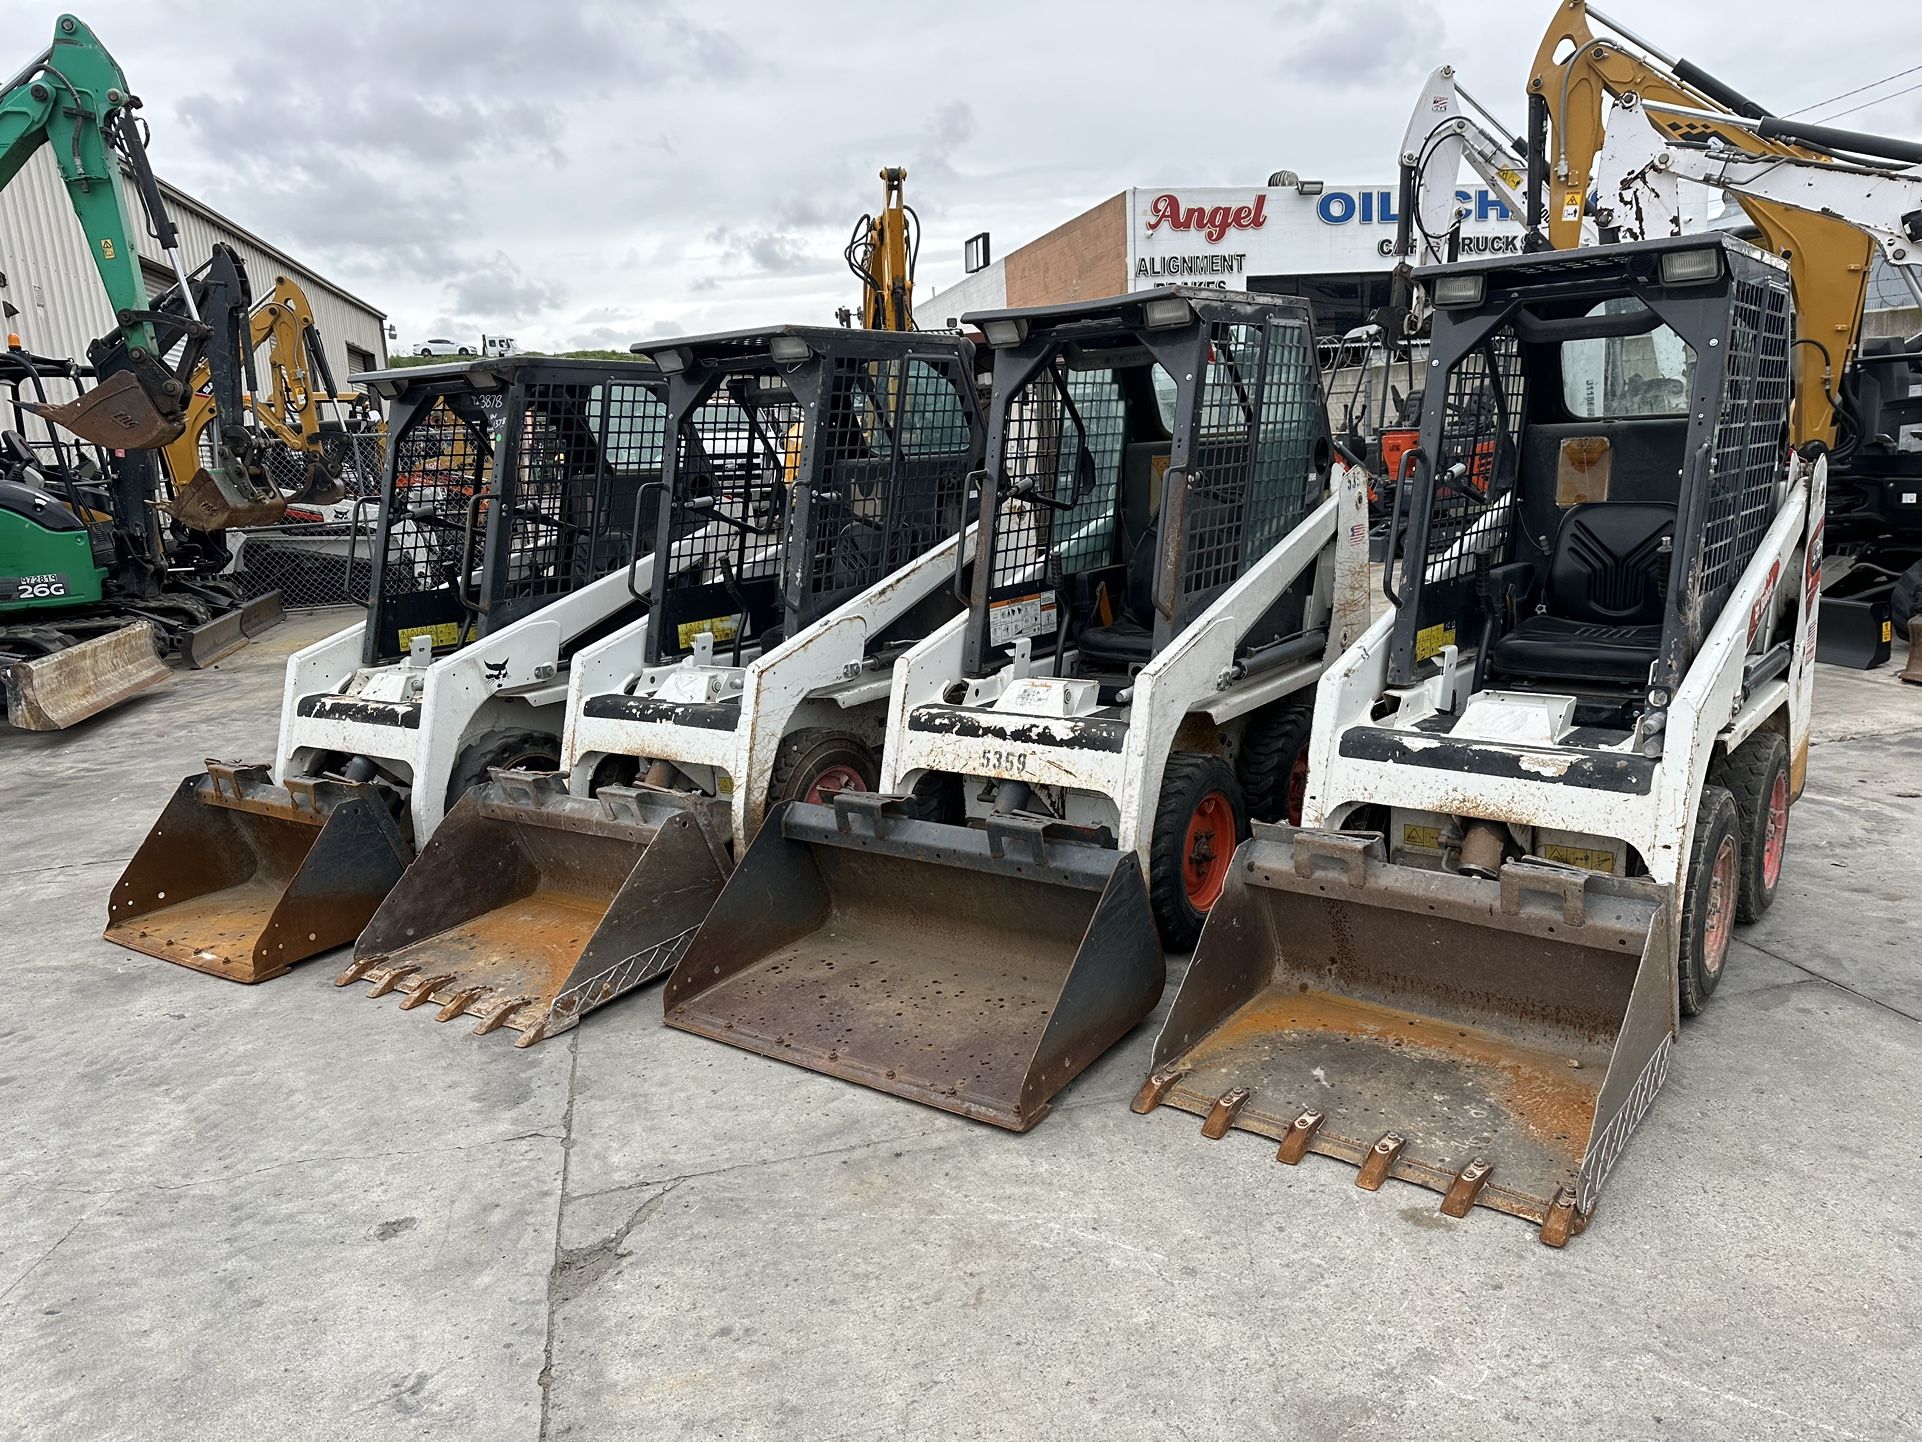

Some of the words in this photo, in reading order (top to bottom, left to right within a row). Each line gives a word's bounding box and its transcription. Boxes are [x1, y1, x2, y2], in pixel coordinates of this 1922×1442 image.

[1146, 193, 1267, 244] Angel
[1317, 190, 1399, 225] OIL
[1136, 253, 1247, 277] ALIGNMENT
[18, 583, 66, 599] 26G
[981, 750, 1028, 774] 5359
